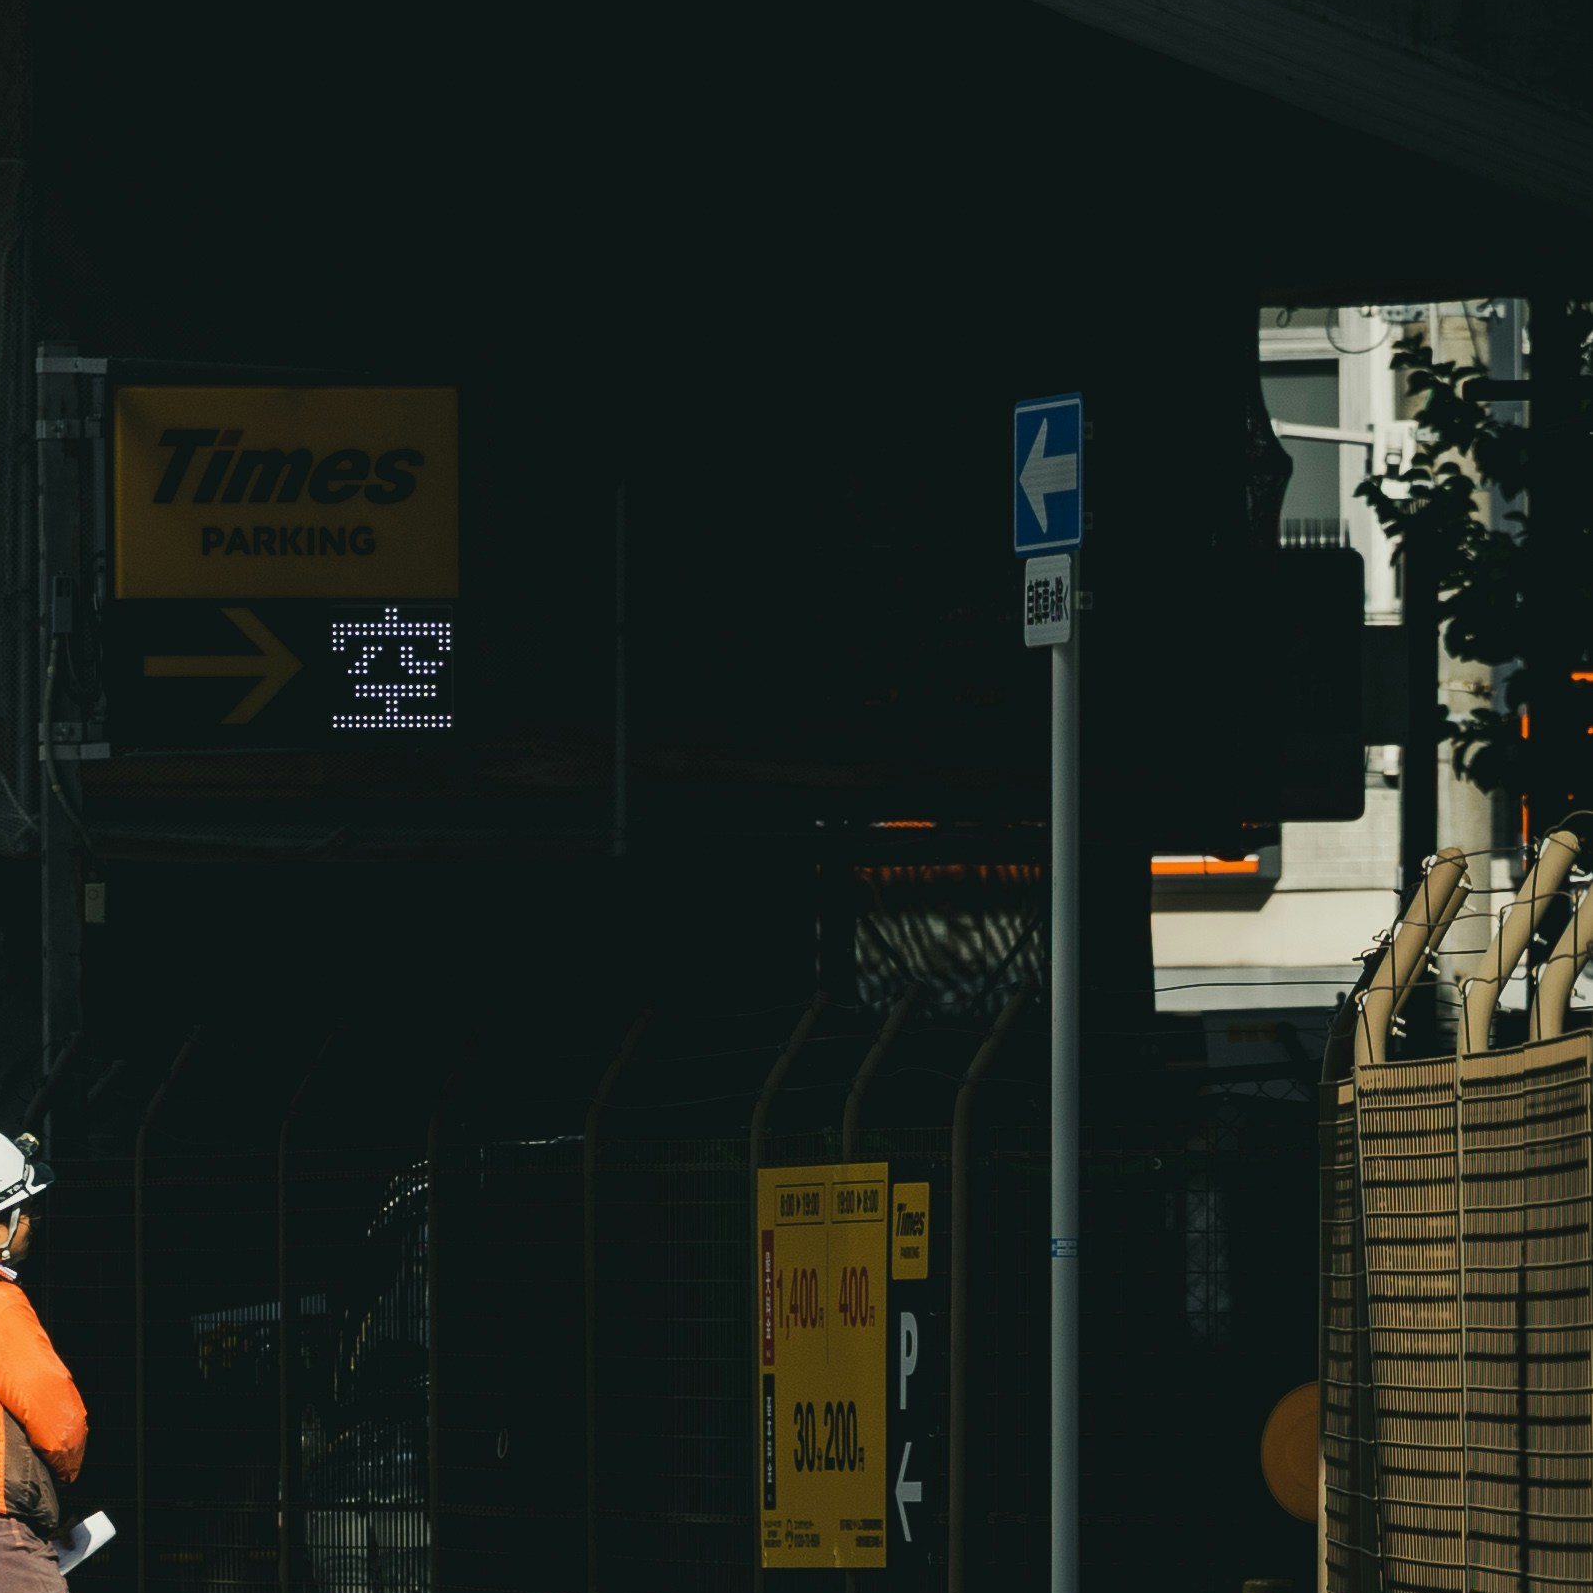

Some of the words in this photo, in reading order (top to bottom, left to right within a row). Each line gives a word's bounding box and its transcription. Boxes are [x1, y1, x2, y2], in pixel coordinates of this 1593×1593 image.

[152, 428, 425, 505] Times
[200, 526, 377, 557] PARKING
[1026, 574, 1069, 626] 自転車を除く
[331, 606, 453, 729] 空
[896, 1203, 926, 1237] Times
[898, 1311, 918, 1409] P
